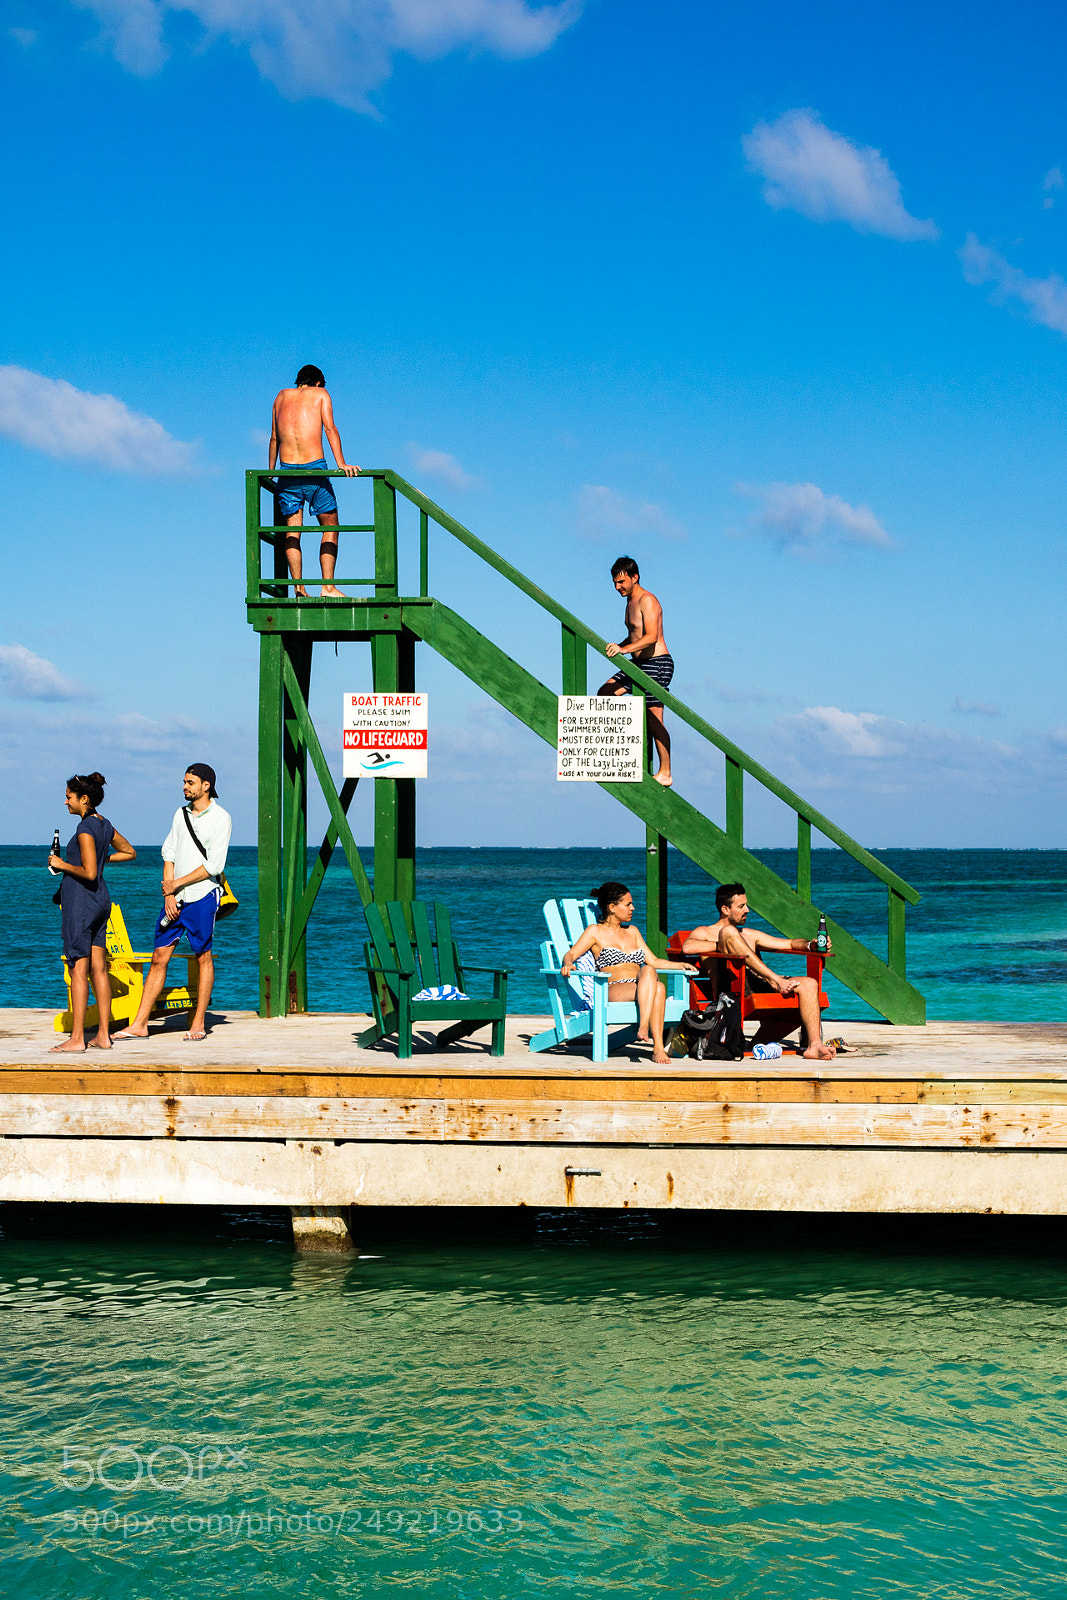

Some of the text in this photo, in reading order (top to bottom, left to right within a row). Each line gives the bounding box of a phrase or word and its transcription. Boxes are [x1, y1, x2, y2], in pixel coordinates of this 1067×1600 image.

[351, 696, 422, 707] BOAT TRAFFIC
[566, 698, 585, 711] Dive
[374, 720, 411, 728] CAUTION!
[562, 717, 633, 725] FOR EXPERIENCED
[603, 726, 626, 734] ONLY.
[344, 732, 424, 746] NO LIFEGUARD
[562, 736, 642, 744] MUST BE OVER 13 YRS.
[562, 748, 630, 756] ONLY FOR CLIENTS
[561, 758, 640, 771] OF THE Lazy Lizard.
